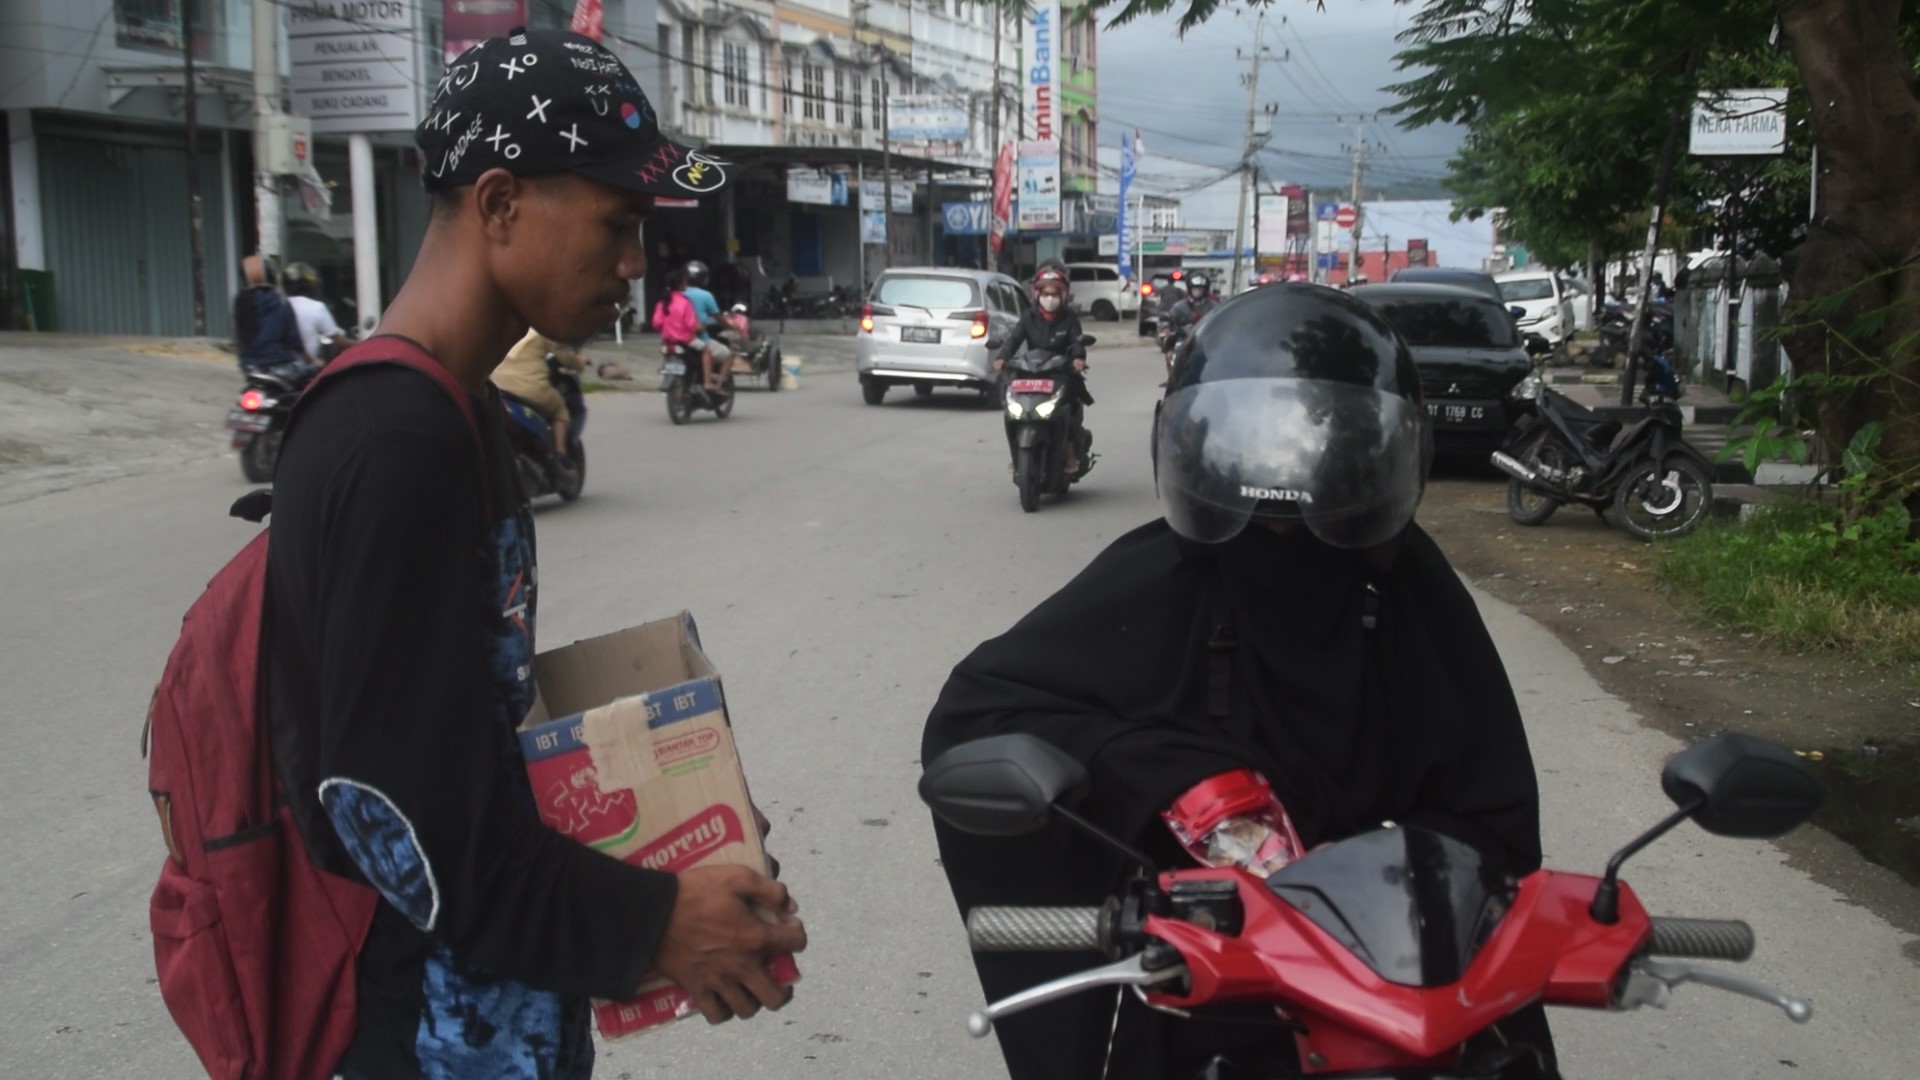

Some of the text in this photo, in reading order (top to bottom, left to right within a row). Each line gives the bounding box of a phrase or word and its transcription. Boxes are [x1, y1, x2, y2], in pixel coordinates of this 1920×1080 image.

[342, 2, 403, 19] MOTOR
[321, 69, 371, 82] BENGKEL
[341, 95, 388, 108] CADANG
[1736, 115, 1778, 133] FARMA
[1240, 485, 1313, 504] HONDA
[535, 732, 559, 751] IBT
[673, 692, 697, 712] IBT
[620, 993, 676, 1024] IBT IBT
